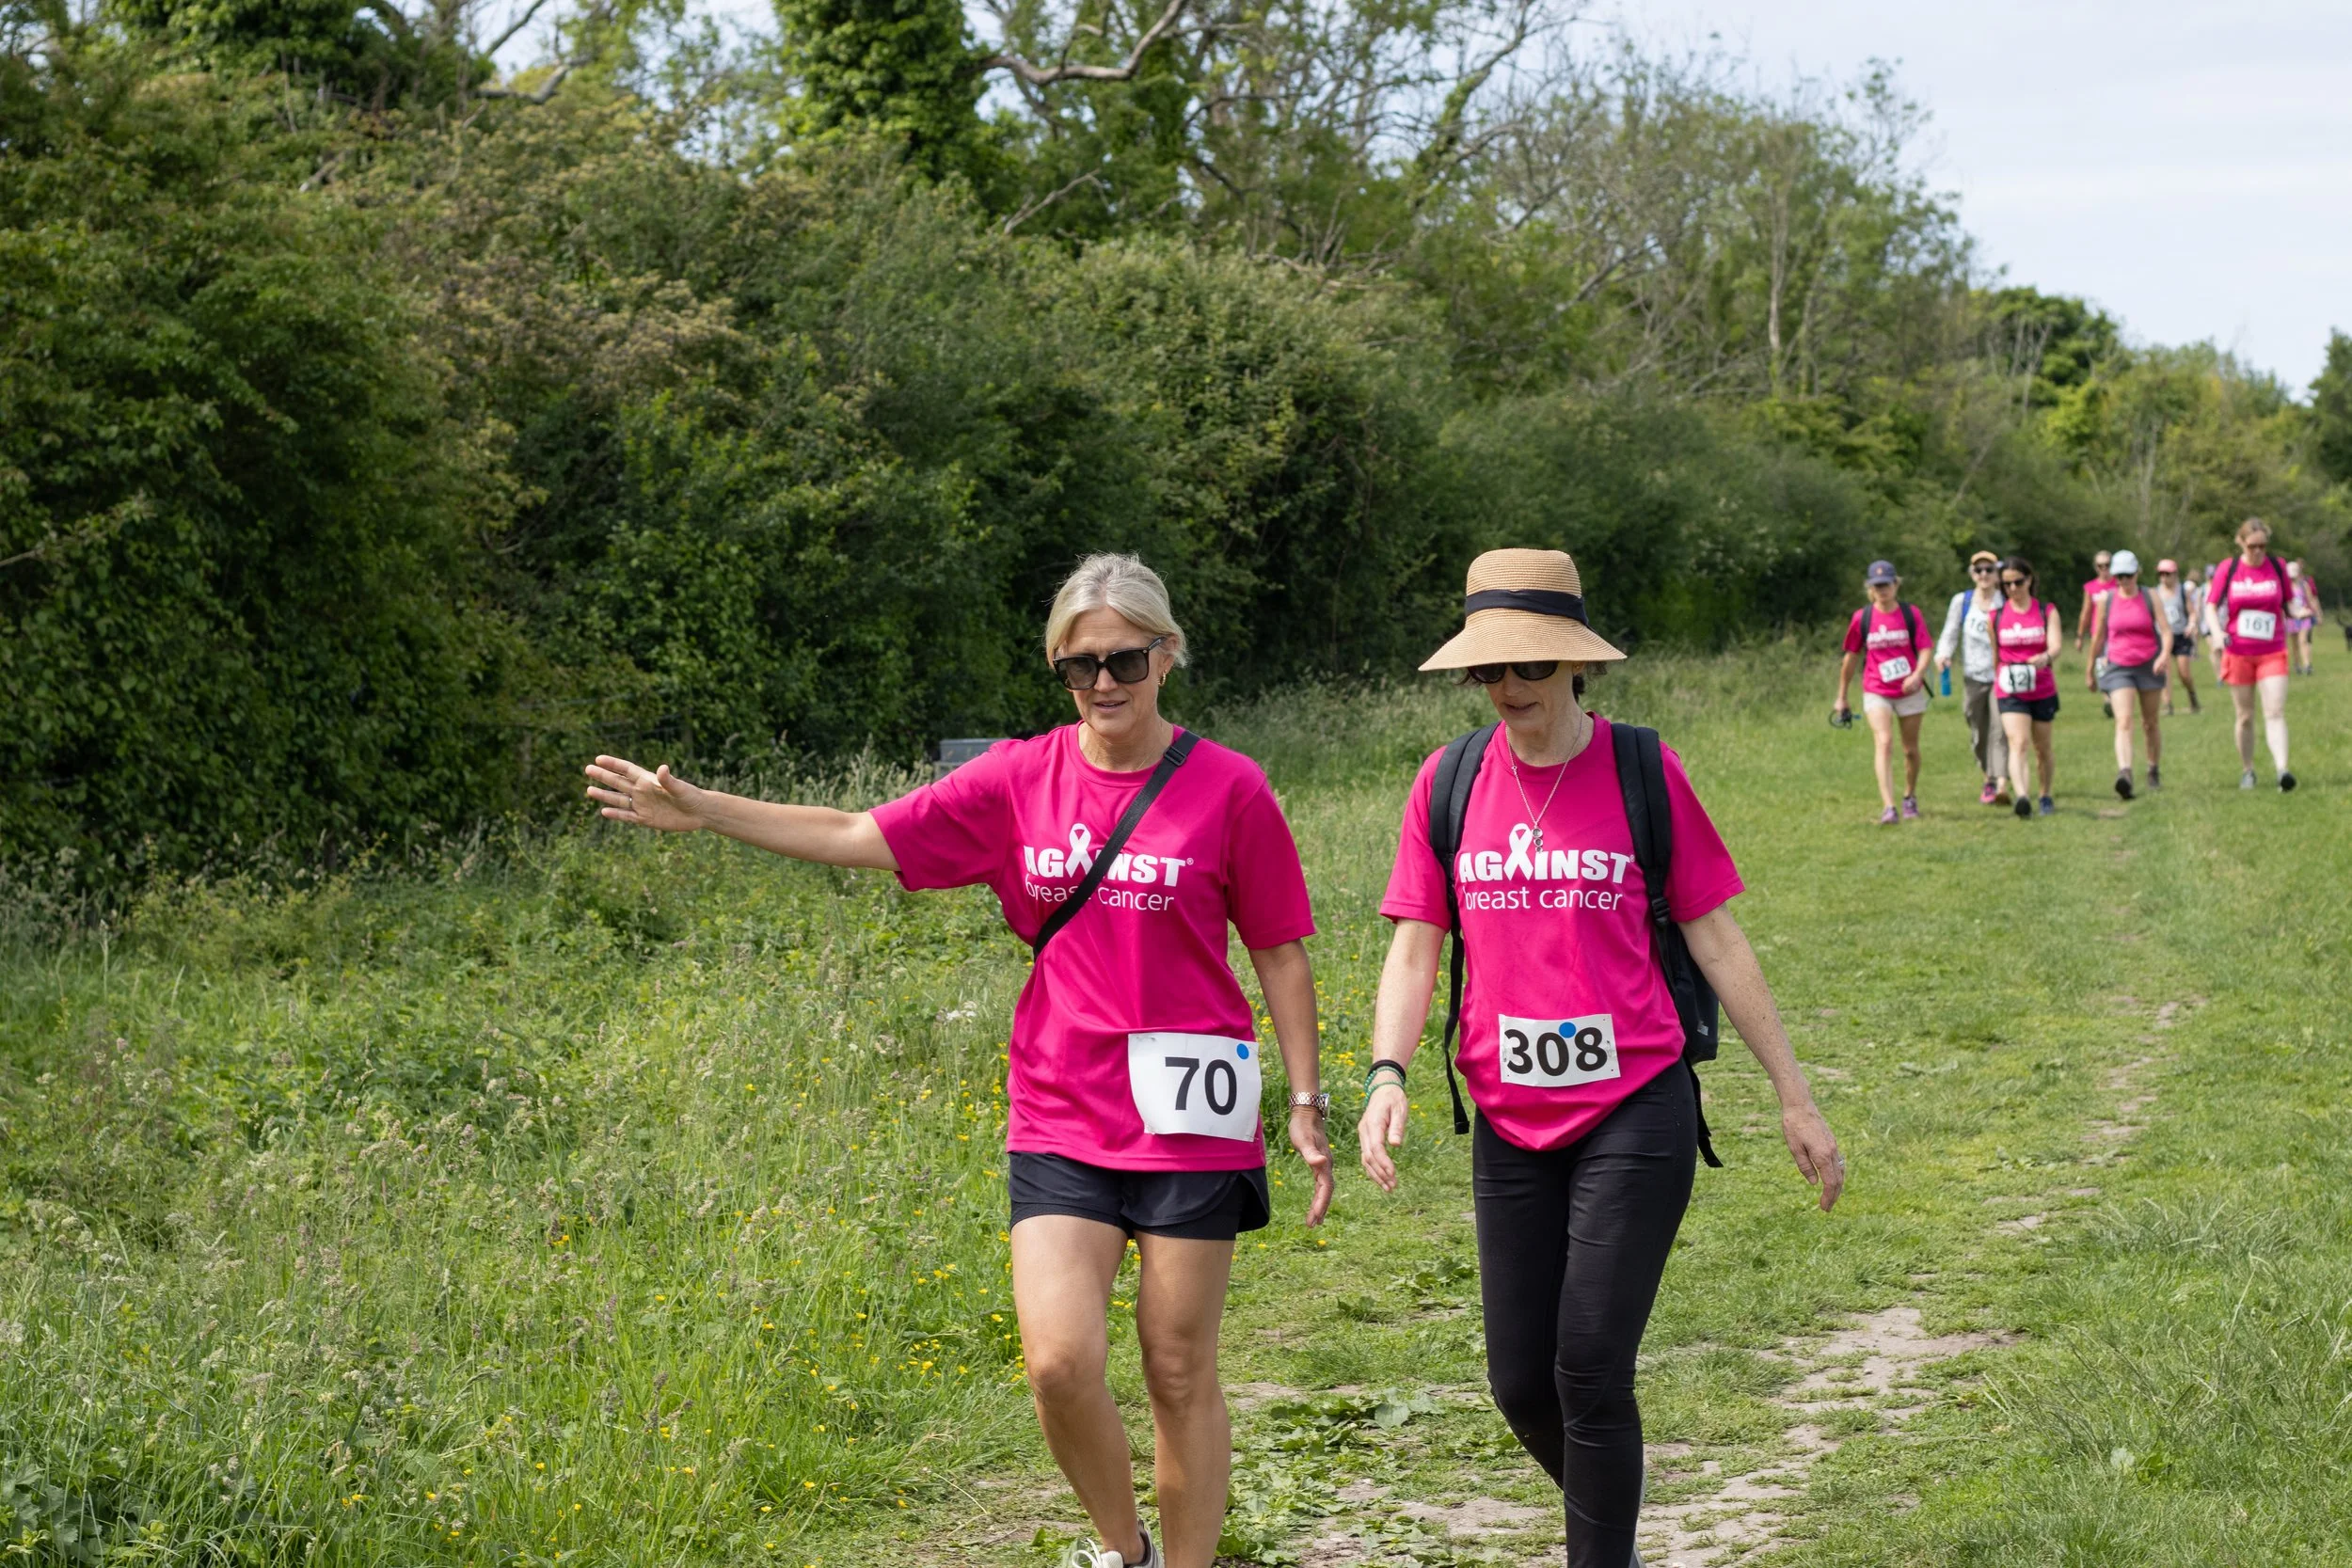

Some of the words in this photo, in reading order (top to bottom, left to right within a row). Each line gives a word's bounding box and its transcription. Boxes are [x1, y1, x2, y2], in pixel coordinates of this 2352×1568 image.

[2245, 616, 2270, 633] 161
[1882, 660, 1909, 679] 310
[1098, 886, 1174, 911] cancer
[1462, 886, 1531, 911] breast
[1539, 888, 1623, 911] cancer
[1504, 1027, 1607, 1076] 308
[1165, 1056, 1237, 1116] 70
